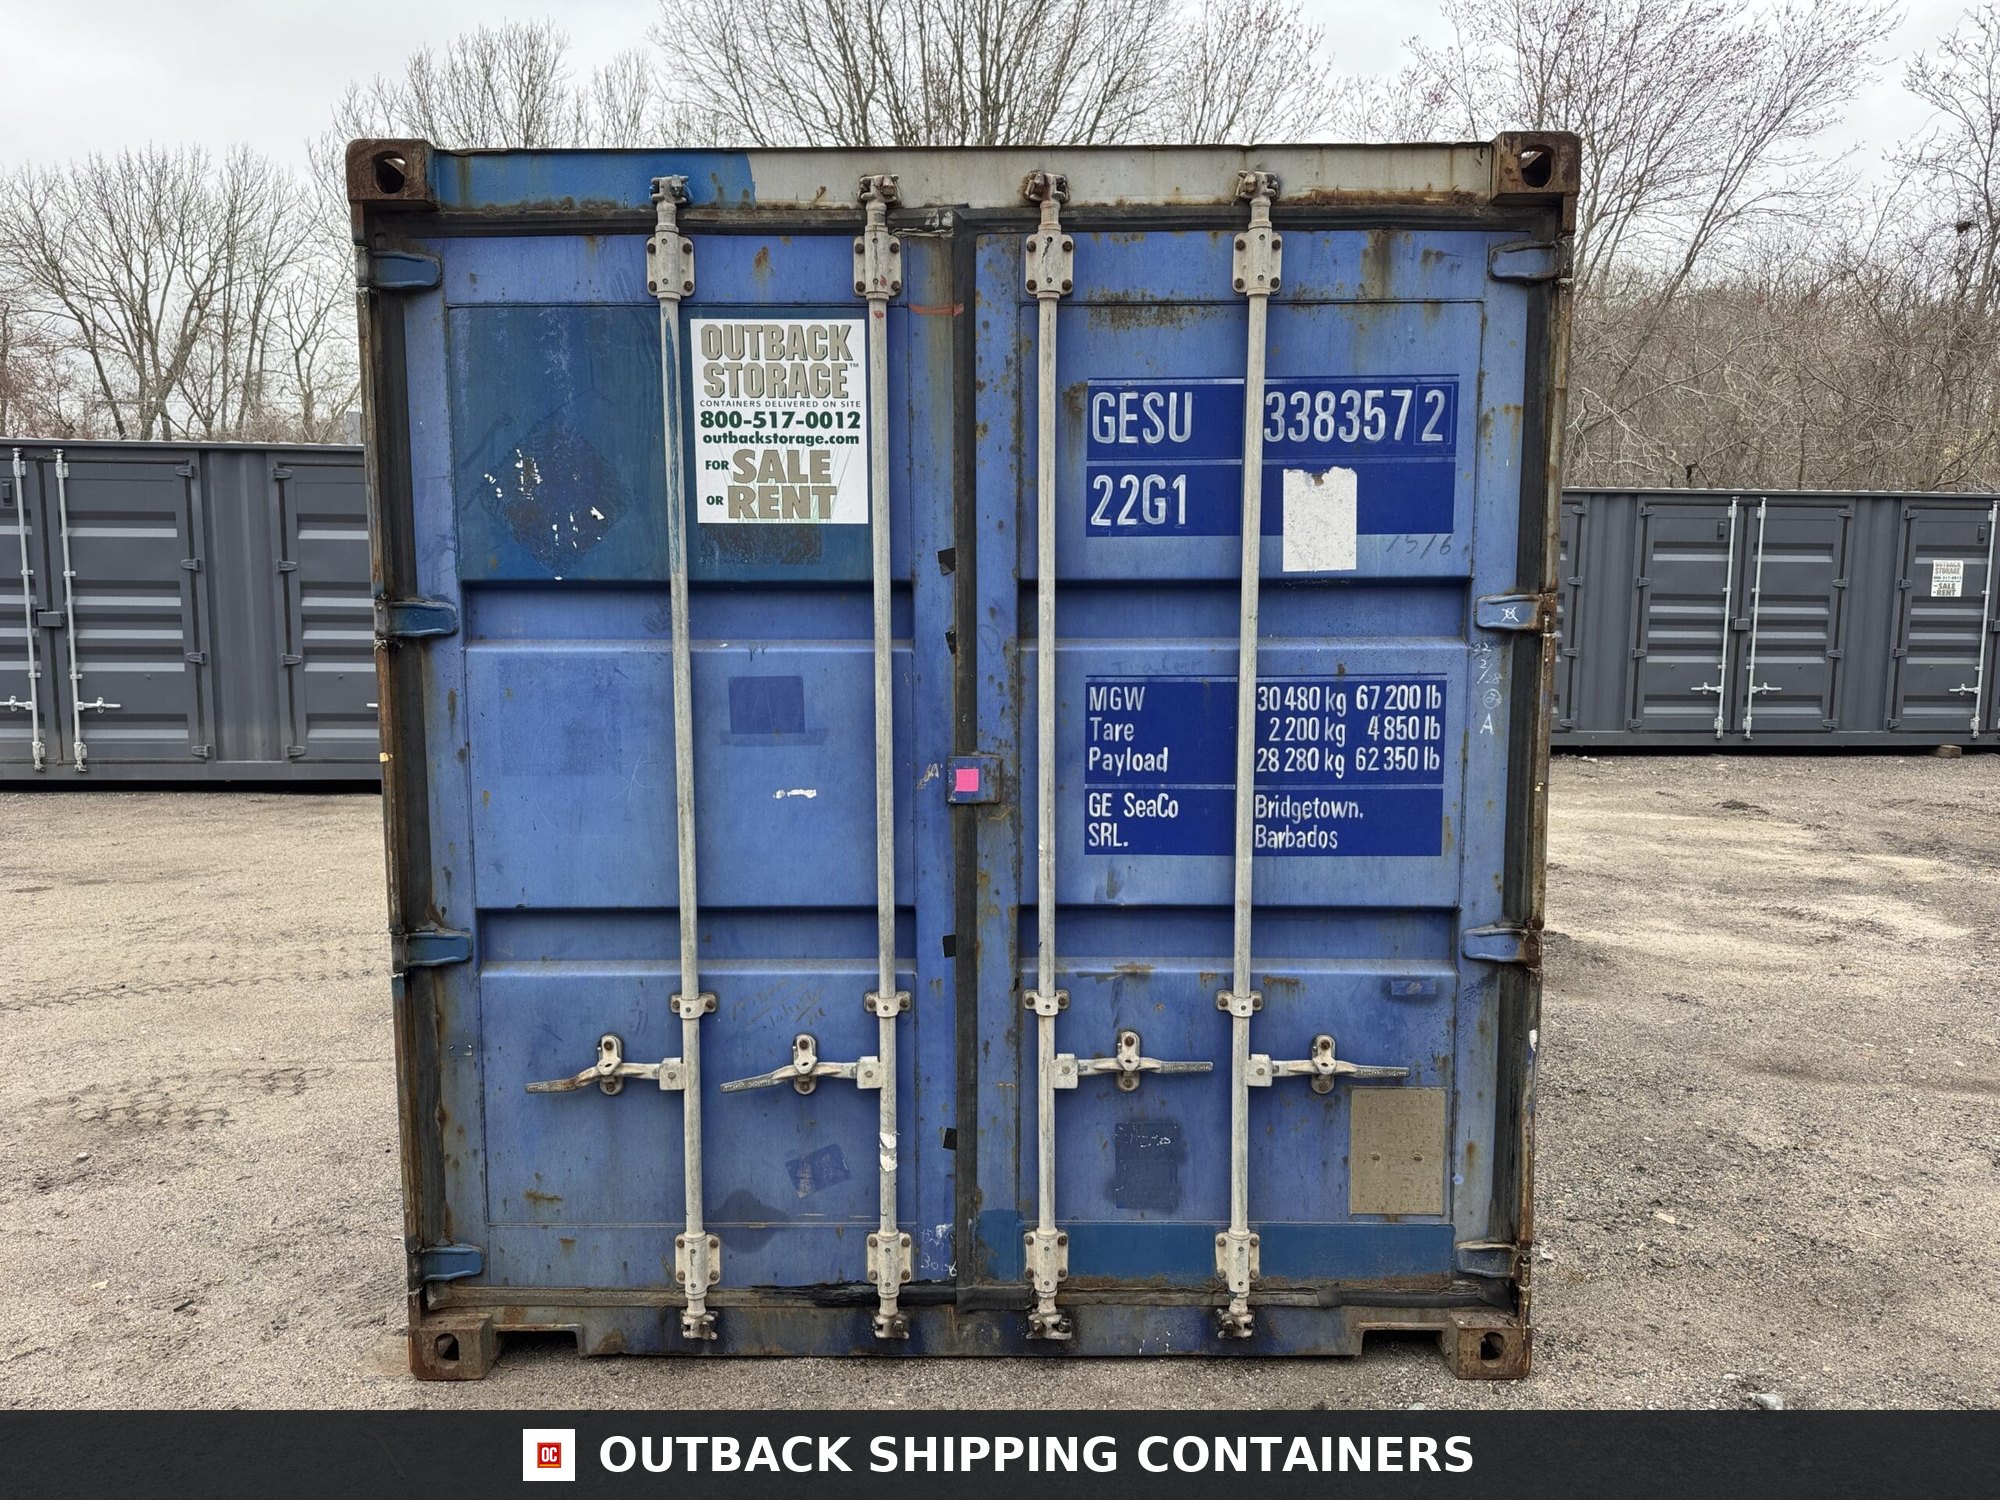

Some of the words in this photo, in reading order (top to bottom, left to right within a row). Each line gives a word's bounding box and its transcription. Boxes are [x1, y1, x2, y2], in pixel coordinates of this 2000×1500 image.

[700, 324, 853, 361] OUTBACK
[703, 362, 849, 399] STORAGE
[700, 400, 762, 408] CONTAINERS
[765, 400, 819, 408] DELIVERED
[822, 400, 837, 408] ON
[840, 400, 861, 408] SITE
[700, 410, 861, 429] 800-517-0012
[1092, 391, 1192, 444] GESU
[703, 431, 860, 447] outbackstorage.com
[705, 460, 729, 470] FOR
[732, 448, 832, 484] SALE
[706, 495, 724, 506] OR
[727, 485, 837, 519] RENT
[1091, 474, 1187, 526] 22G1
[1089, 686, 1146, 711] MGW
[1257, 686, 1281, 711] 30
[1284, 686, 1320, 711] 480
[1325, 686, 1347, 717] kg
[1355, 685, 1380, 710] 67
[1384, 685, 1421, 711] 200
[1426, 684, 1442, 710] lb
[1089, 717, 1135, 742] Tare
[1268, 717, 1281, 741] 2
[1284, 717, 1320, 741] 200
[1324, 717, 1346, 748] kg
[1367, 715, 1380, 741] 4
[1383, 715, 1420, 741] 850
[1424, 715, 1441, 740] lb
[1479, 713, 1495, 735] A
[1088, 747, 1168, 777] Payload
[1256, 747, 1280, 772] 28
[1284, 747, 1319, 772] 280
[1324, 748, 1345, 779] kg
[1355, 747, 1380, 771] 62
[1383, 747, 1419, 771] 350
[1424, 746, 1440, 771] lb
[1088, 792, 1113, 817] GE
[1123, 792, 1179, 818] SeaCo
[1088, 822, 1129, 847] SRL.
[1255, 824, 1338, 849] Barbados
